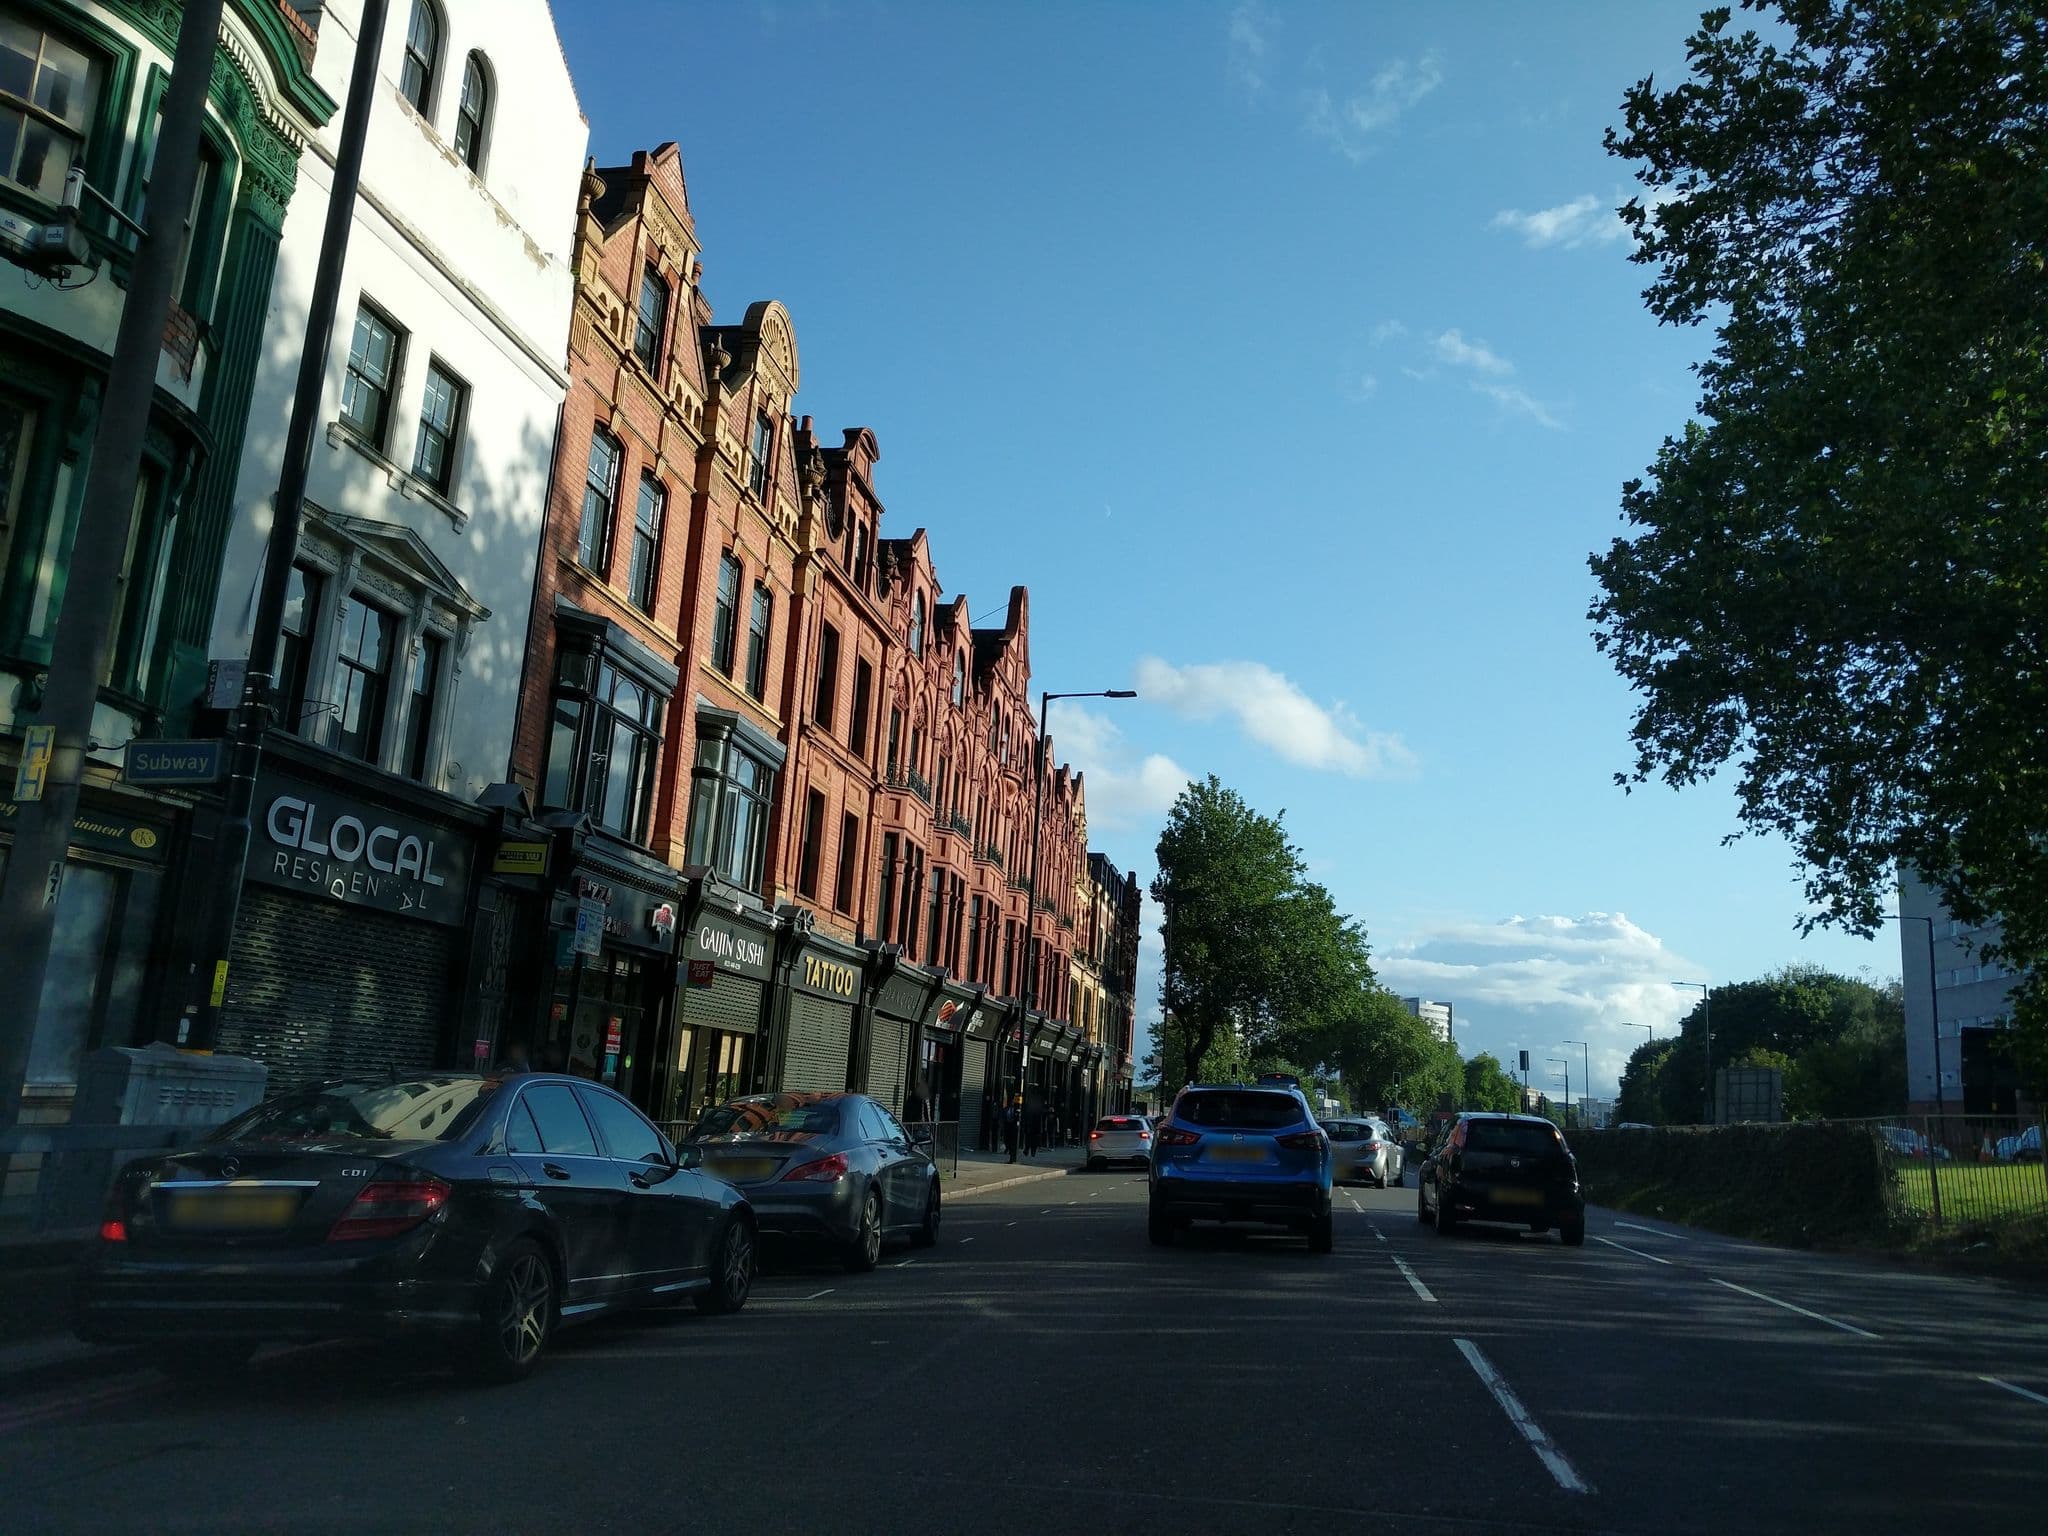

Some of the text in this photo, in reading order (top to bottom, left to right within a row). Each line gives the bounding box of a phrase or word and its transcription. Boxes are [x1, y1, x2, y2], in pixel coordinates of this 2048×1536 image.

[136, 753, 209, 773] Subway
[267, 795, 445, 887] GLOCAL
[701, 926, 764, 966] GAIJIN SUSHI
[690, 963, 711, 971] JUST
[805, 955, 854, 996] TATTOO
[341, 1169, 367, 1177] CDI
